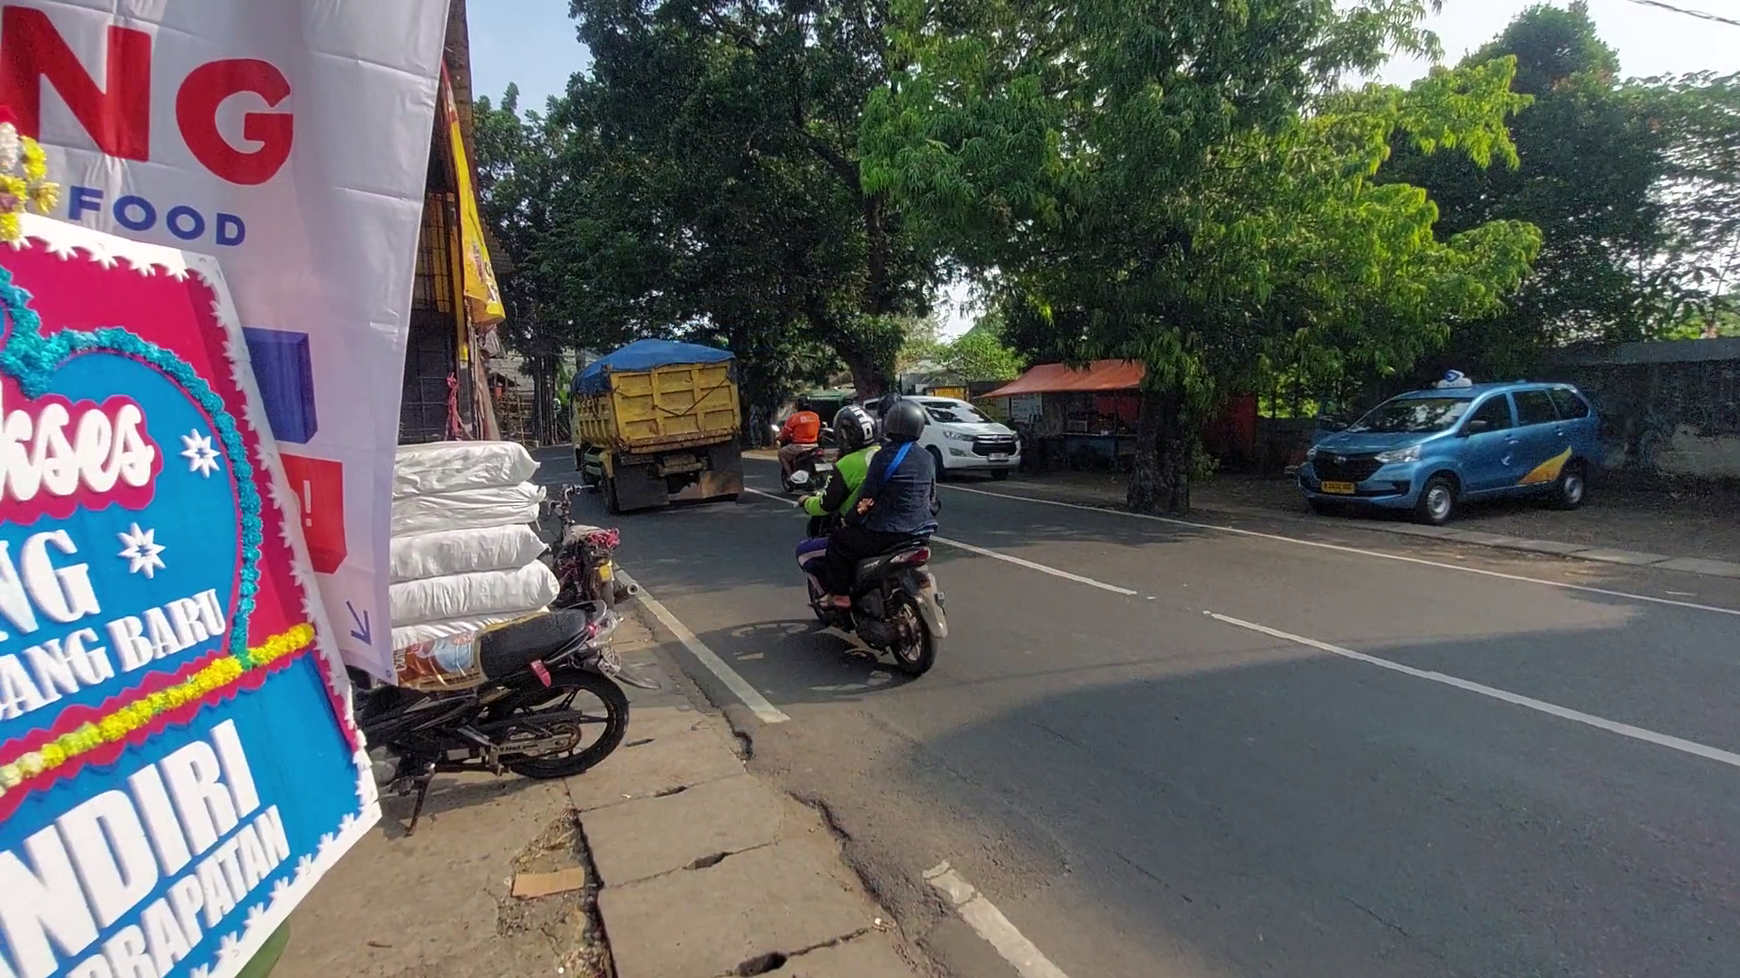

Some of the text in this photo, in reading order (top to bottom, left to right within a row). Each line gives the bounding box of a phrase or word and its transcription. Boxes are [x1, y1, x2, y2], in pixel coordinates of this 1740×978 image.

[68, 185, 246, 247] FOOD
[106, 589, 226, 673] BARU
[0, 718, 260, 978] NDIRI
